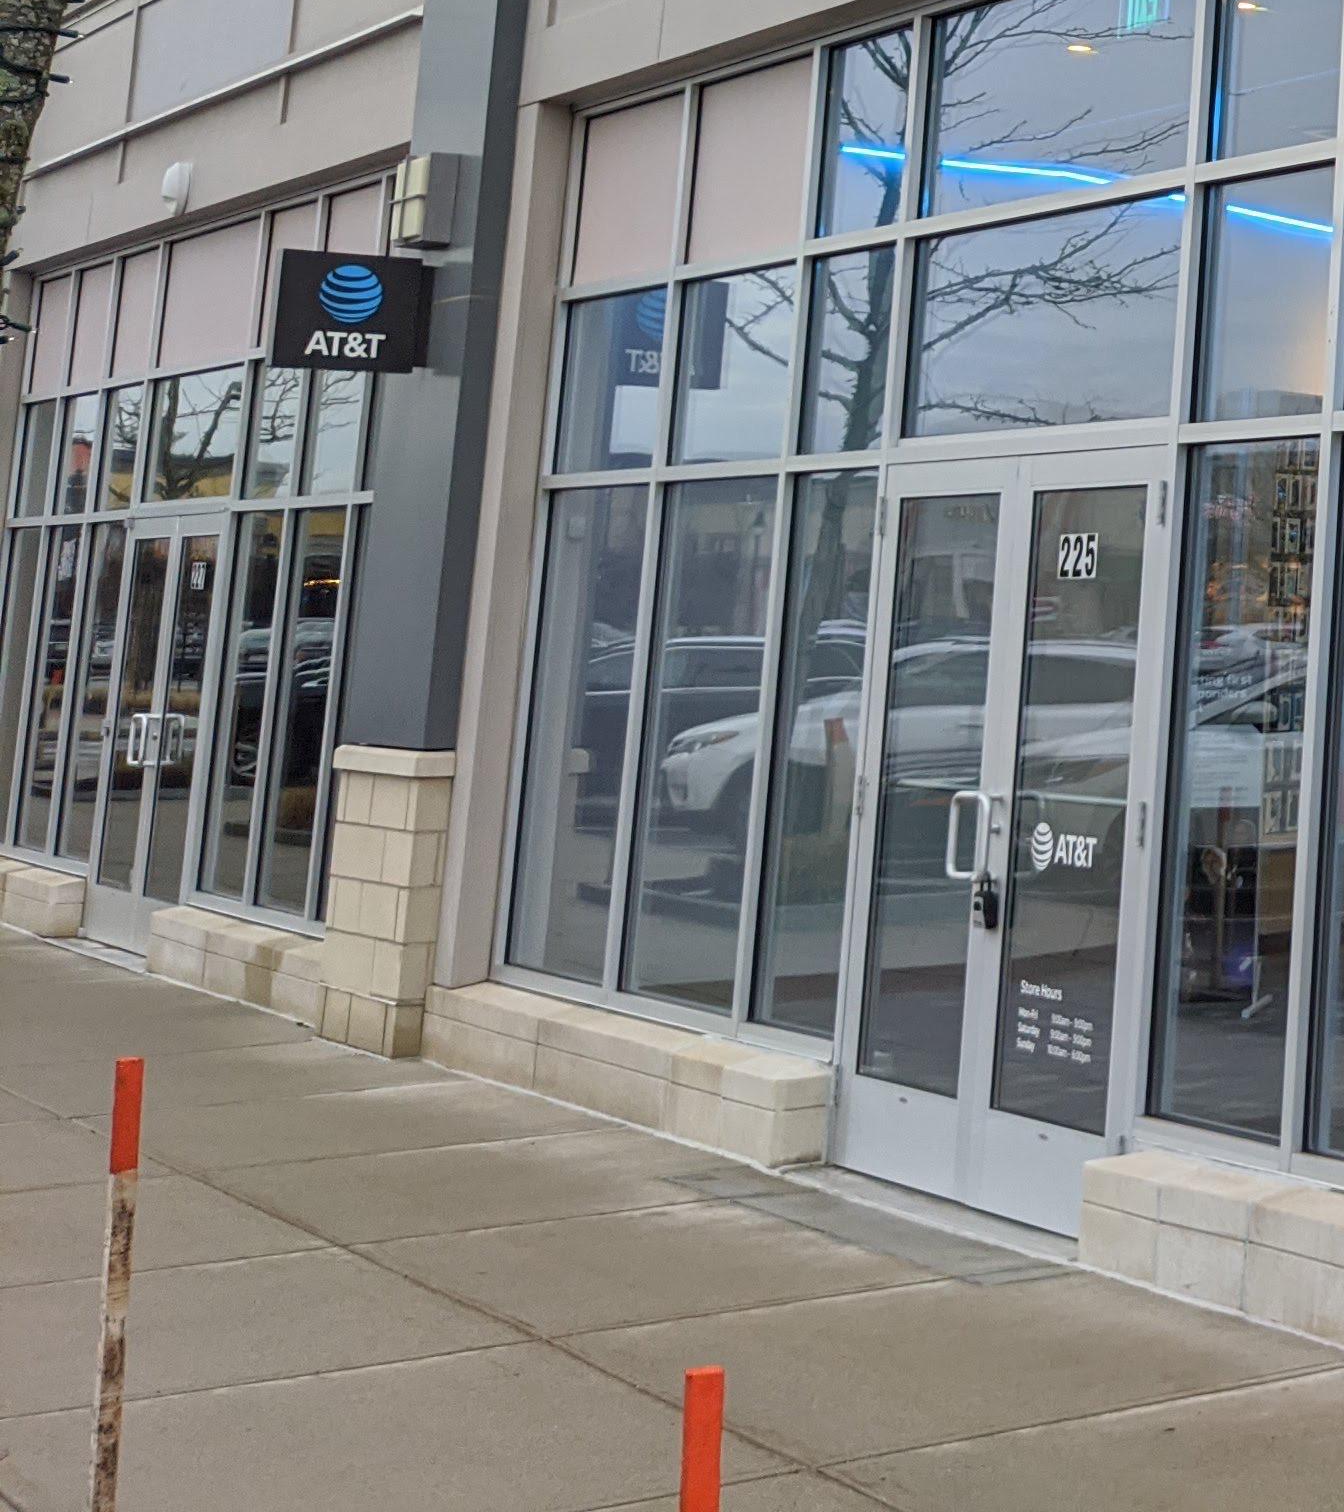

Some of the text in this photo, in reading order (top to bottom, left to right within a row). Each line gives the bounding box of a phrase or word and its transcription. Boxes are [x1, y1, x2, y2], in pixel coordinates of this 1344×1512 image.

[304, 330, 387, 359] AT&T
[1059, 533, 1097, 578] 225
[1054, 833, 1098, 869] AT&T
[1020, 979, 1063, 1001] Store Hours
